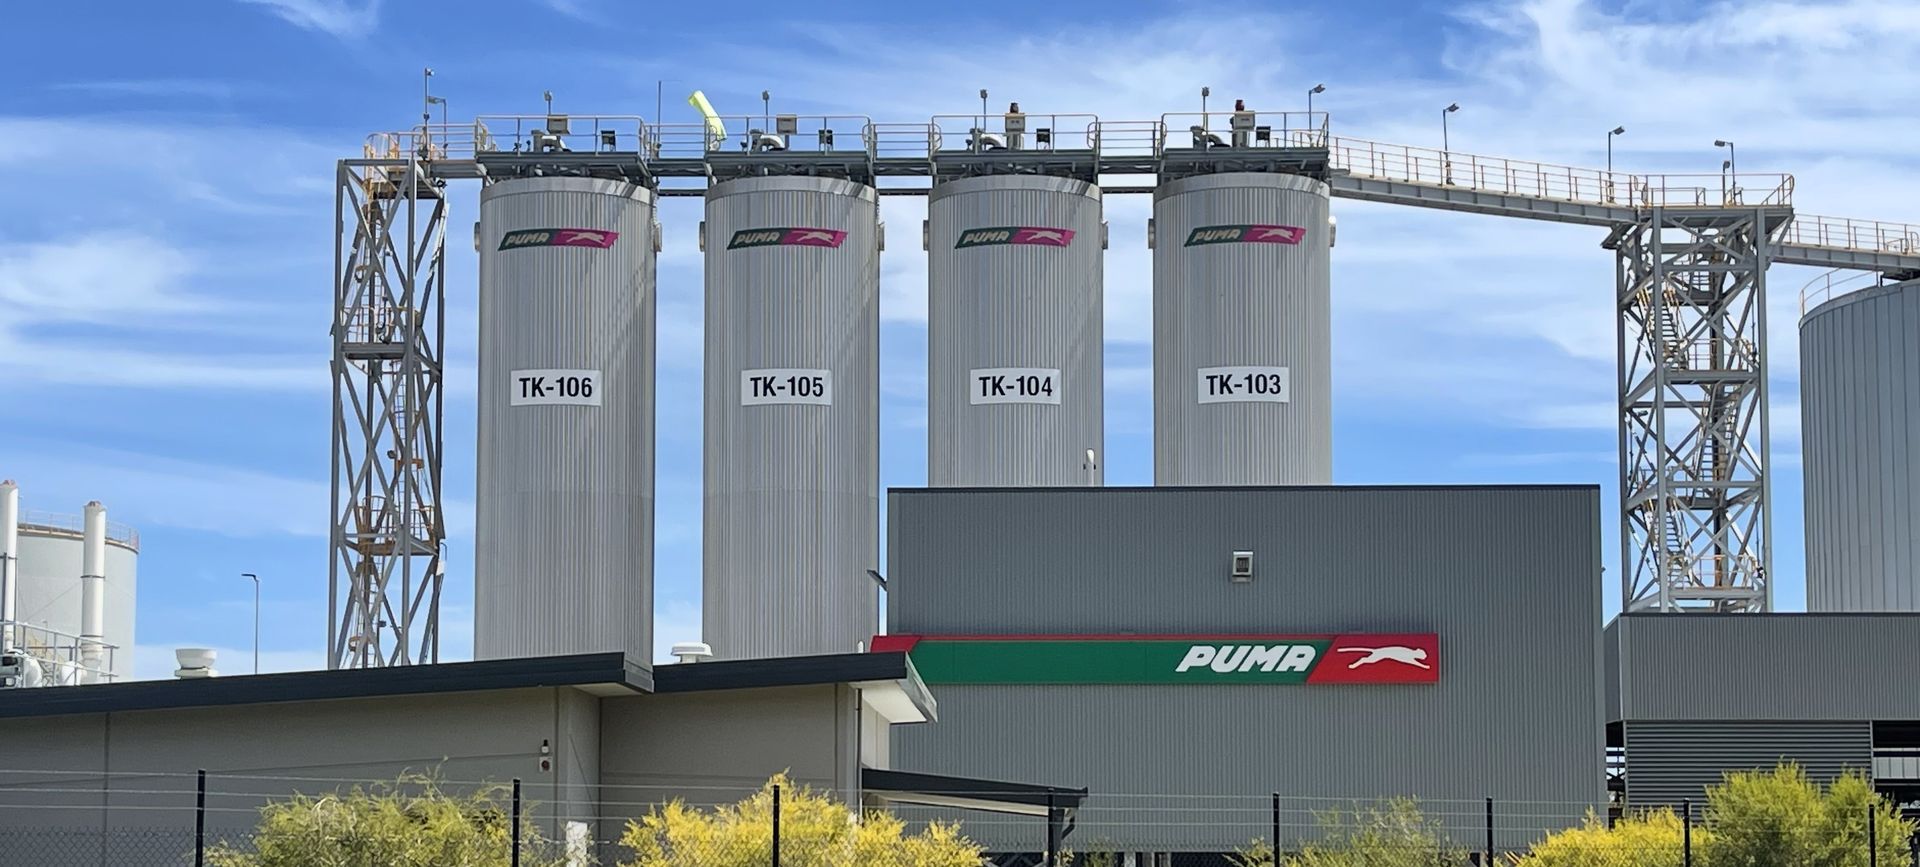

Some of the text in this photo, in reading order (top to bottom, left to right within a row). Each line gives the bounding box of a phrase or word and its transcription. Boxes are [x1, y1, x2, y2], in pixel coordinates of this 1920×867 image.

[505, 231, 550, 247] PUMA
[734, 231, 780, 246] PUMA
[963, 230, 1010, 245] PUMA
[1192, 228, 1241, 243] PUMA
[519, 376, 593, 398] TK-106
[750, 376, 824, 397] TK-105
[978, 375, 1053, 397] TK-104
[1206, 374, 1282, 396] TK-103
[1175, 645, 1316, 673] PUMA
